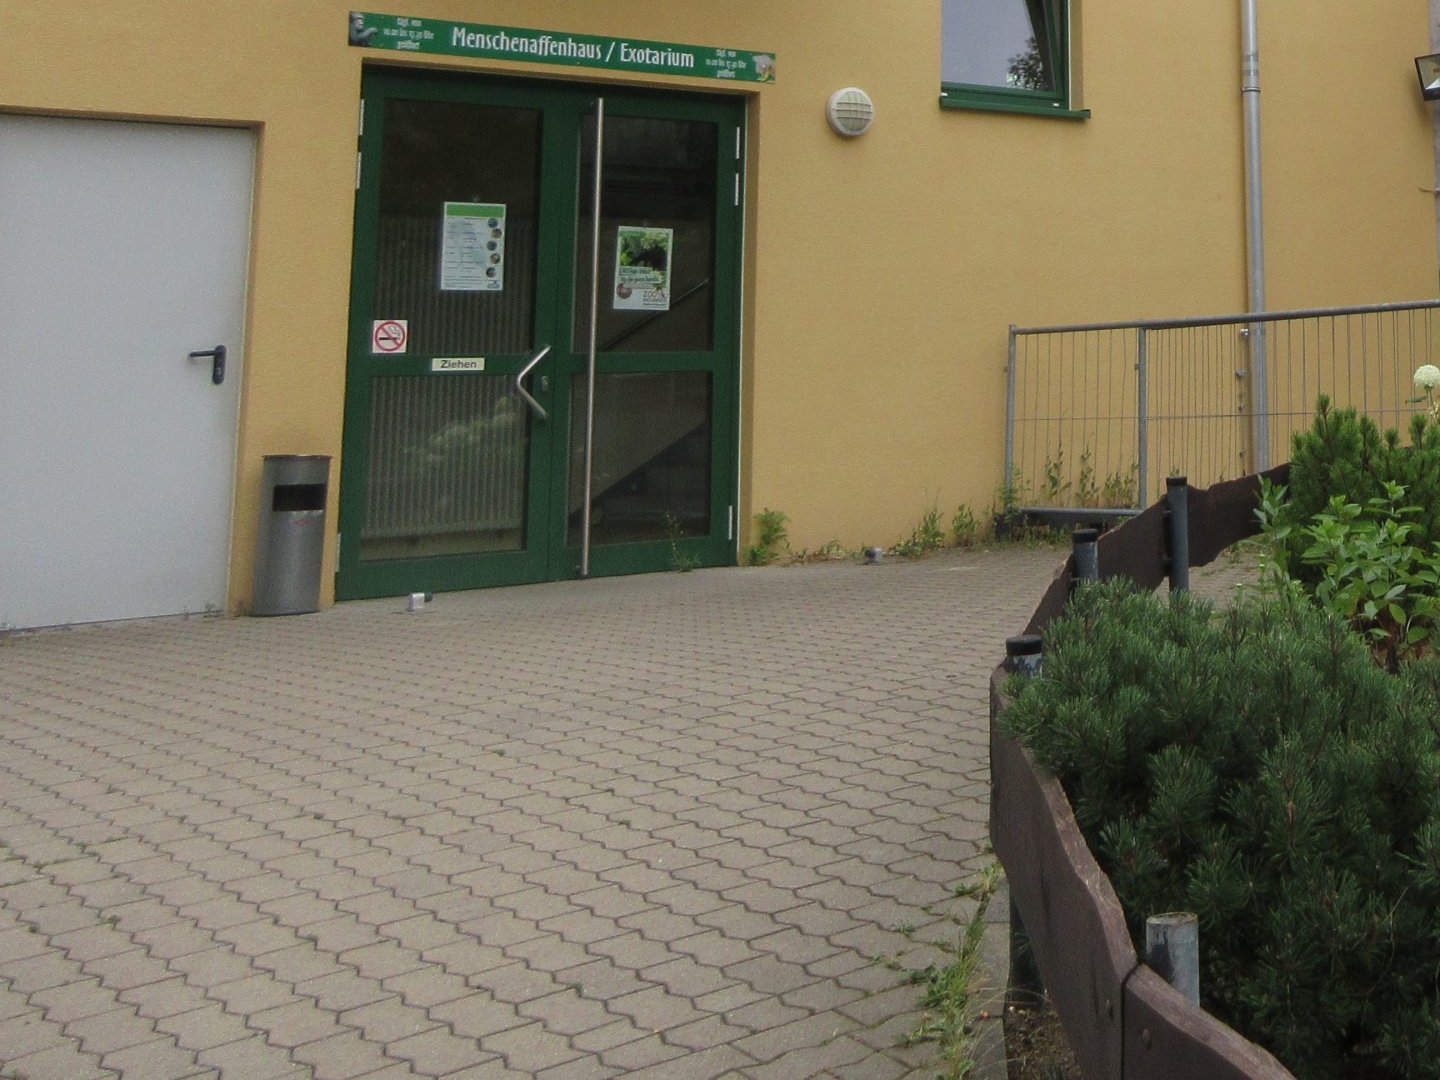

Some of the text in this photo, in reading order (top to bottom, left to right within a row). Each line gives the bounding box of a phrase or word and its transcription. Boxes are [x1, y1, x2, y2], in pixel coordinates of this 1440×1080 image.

[452, 27, 694, 67] Menschenaffenhaus / Exotarium
[440, 359, 477, 369] Ziehen
